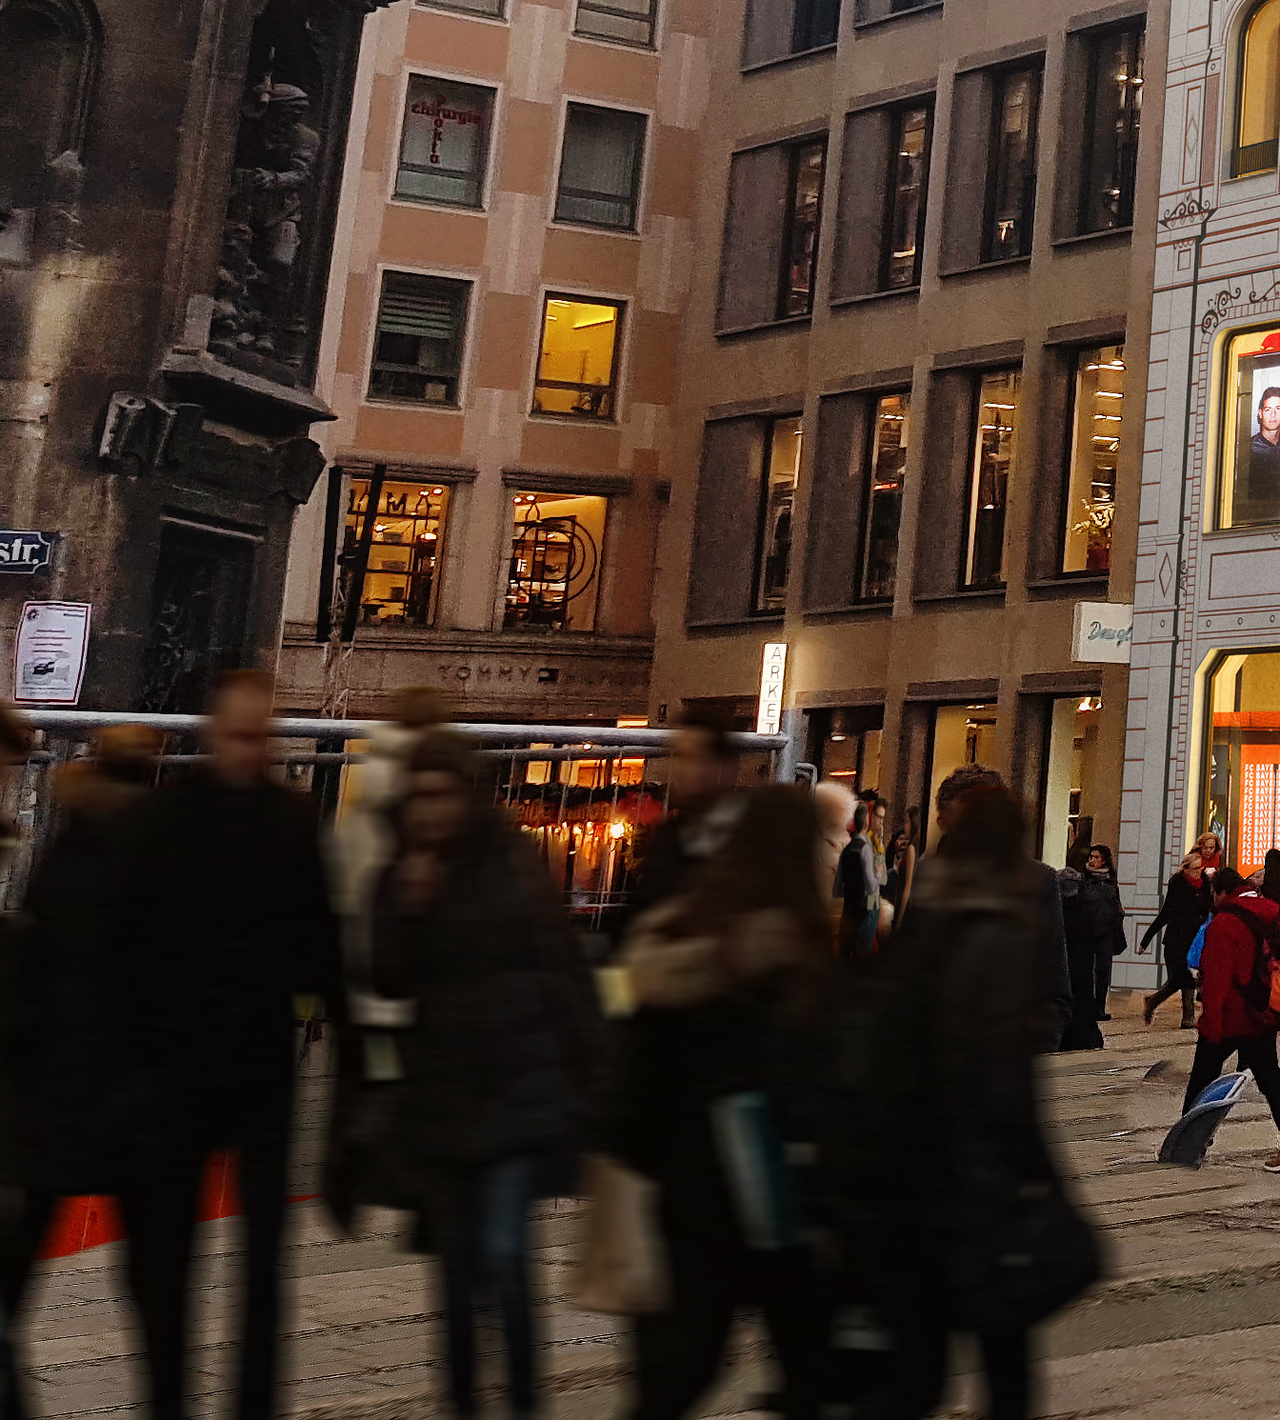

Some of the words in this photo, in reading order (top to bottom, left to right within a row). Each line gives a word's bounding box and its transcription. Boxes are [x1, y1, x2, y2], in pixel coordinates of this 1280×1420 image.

[0, 538, 40, 565] str.
[439, 666, 532, 680] TOMMY
[765, 646, 782, 733] ARKET
